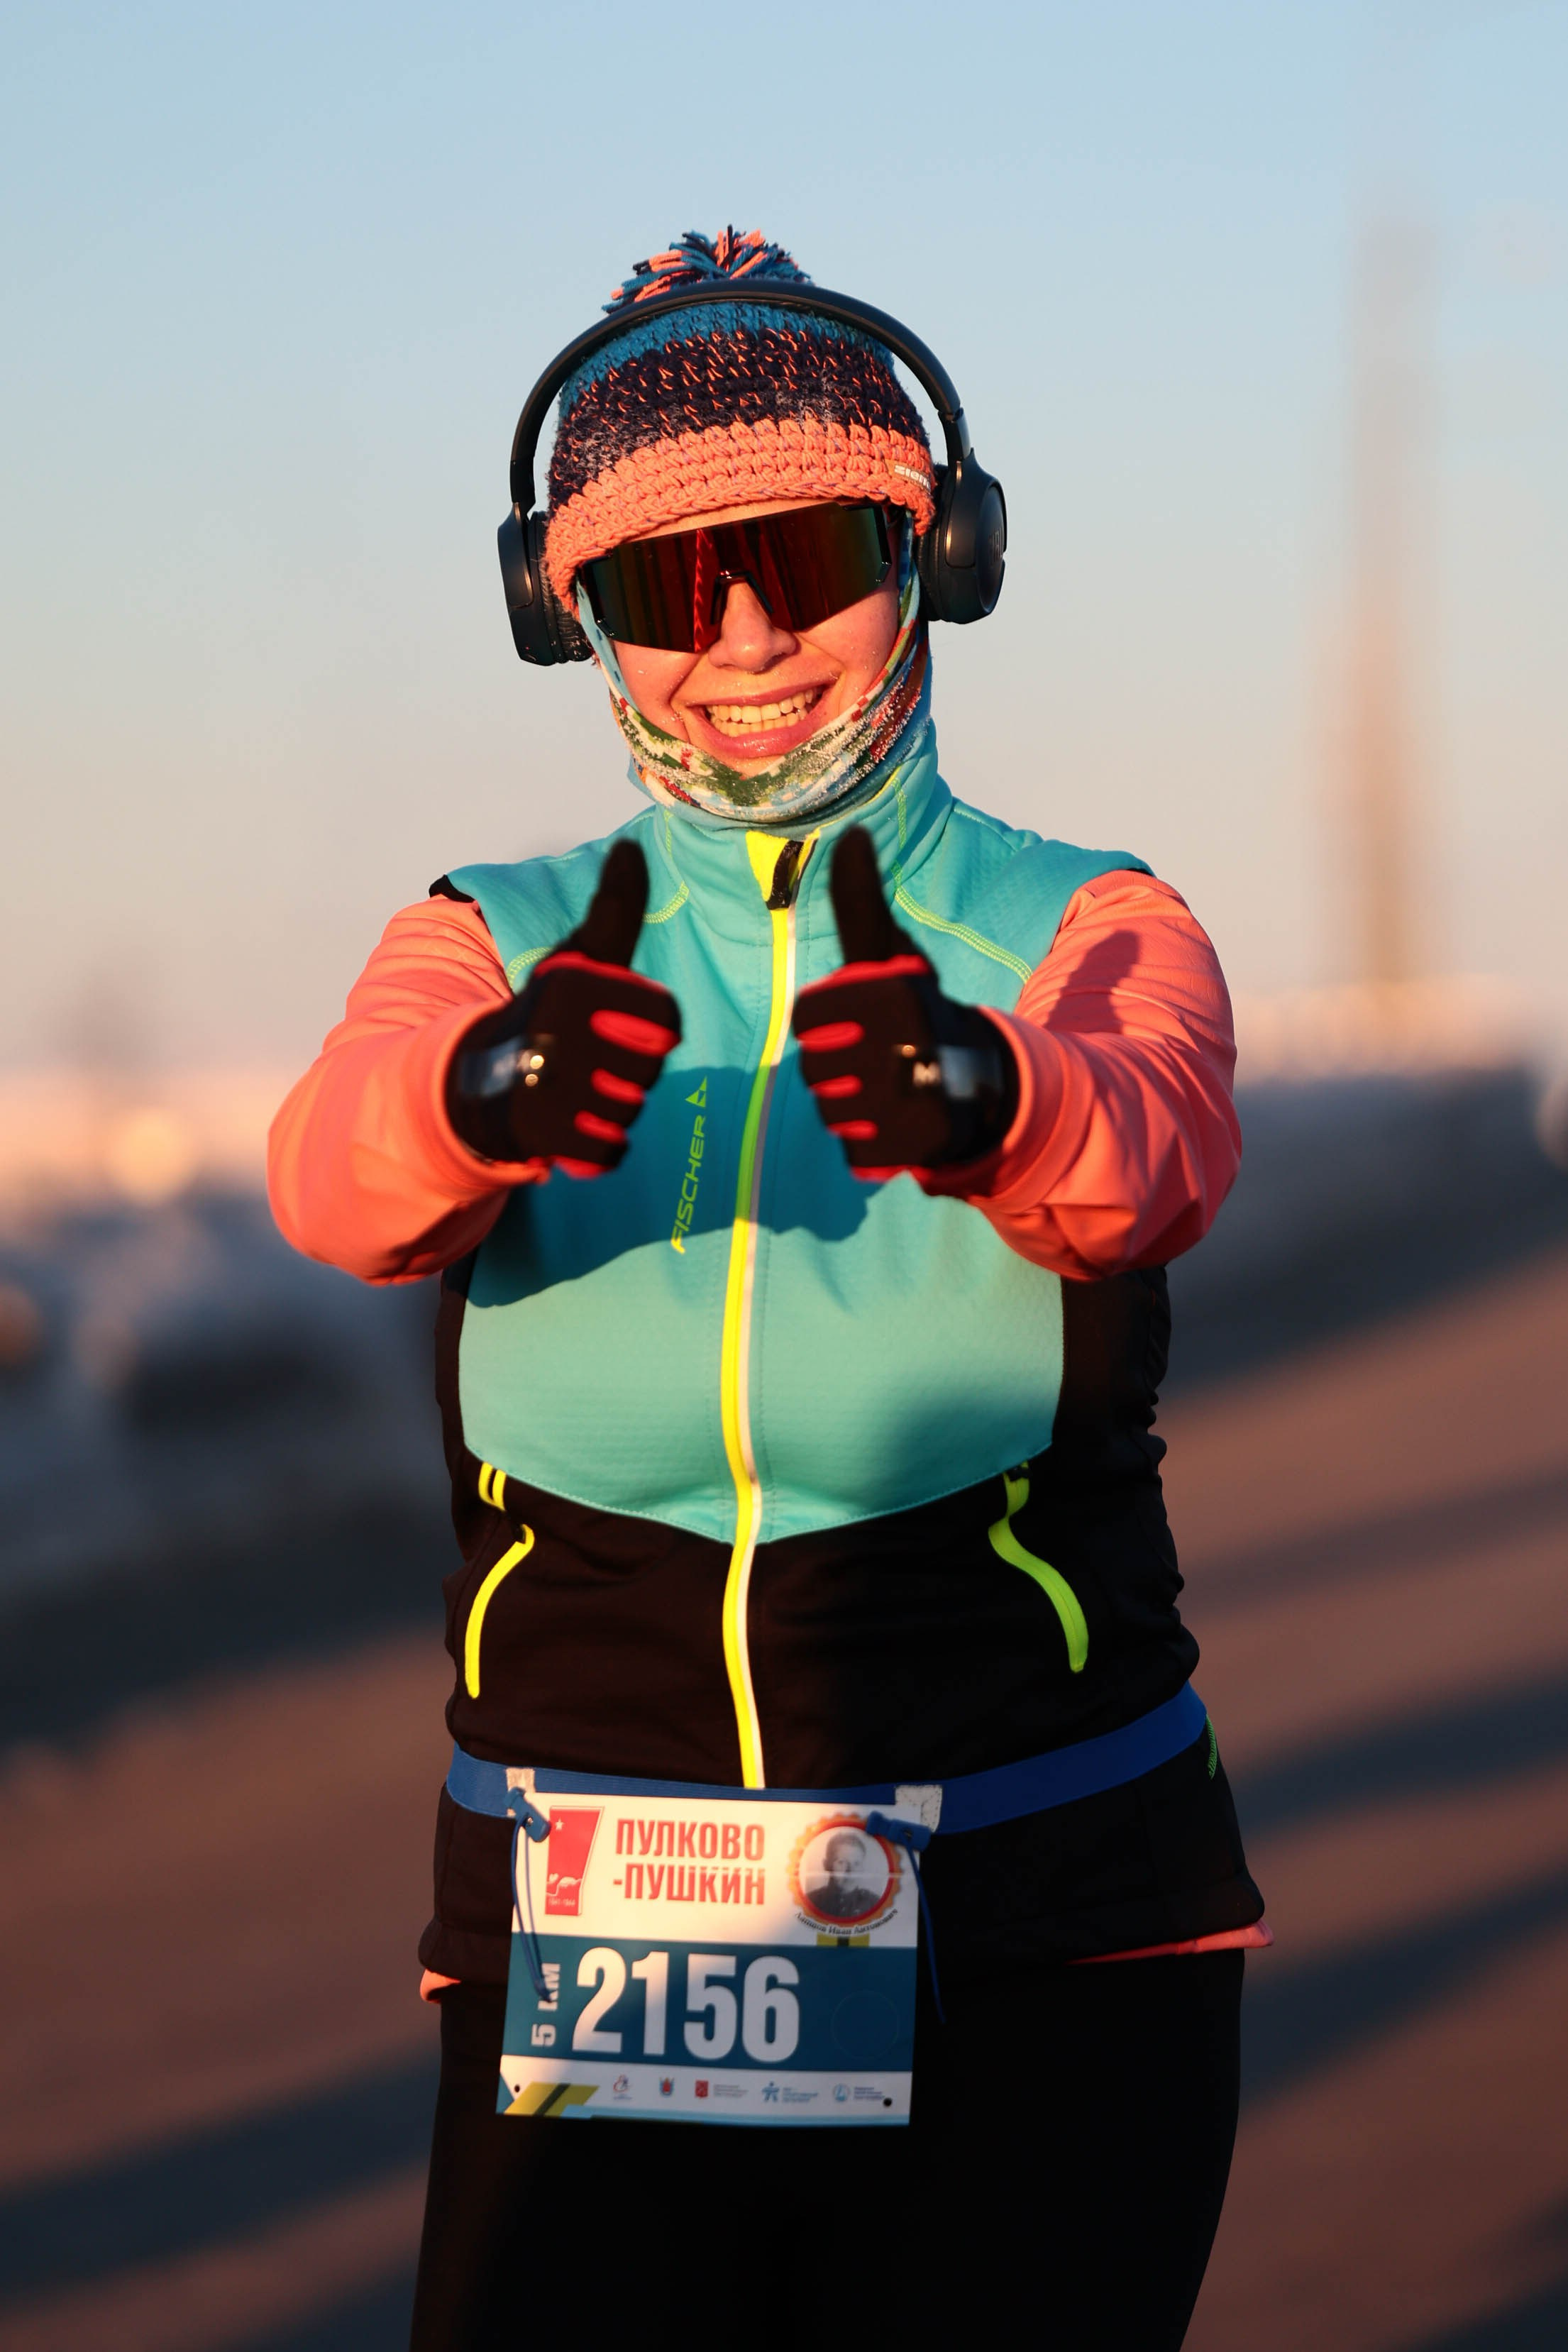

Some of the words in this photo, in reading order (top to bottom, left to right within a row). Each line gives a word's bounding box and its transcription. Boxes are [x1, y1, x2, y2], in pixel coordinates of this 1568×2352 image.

[670, 1115, 706, 1254] FISCHER
[616, 1818, 765, 1860] ПУЛКОВО
[613, 1863, 765, 1905] -ПУШКИН
[572, 1947, 800, 2063] 2156
[530, 2023, 556, 2047] 5
